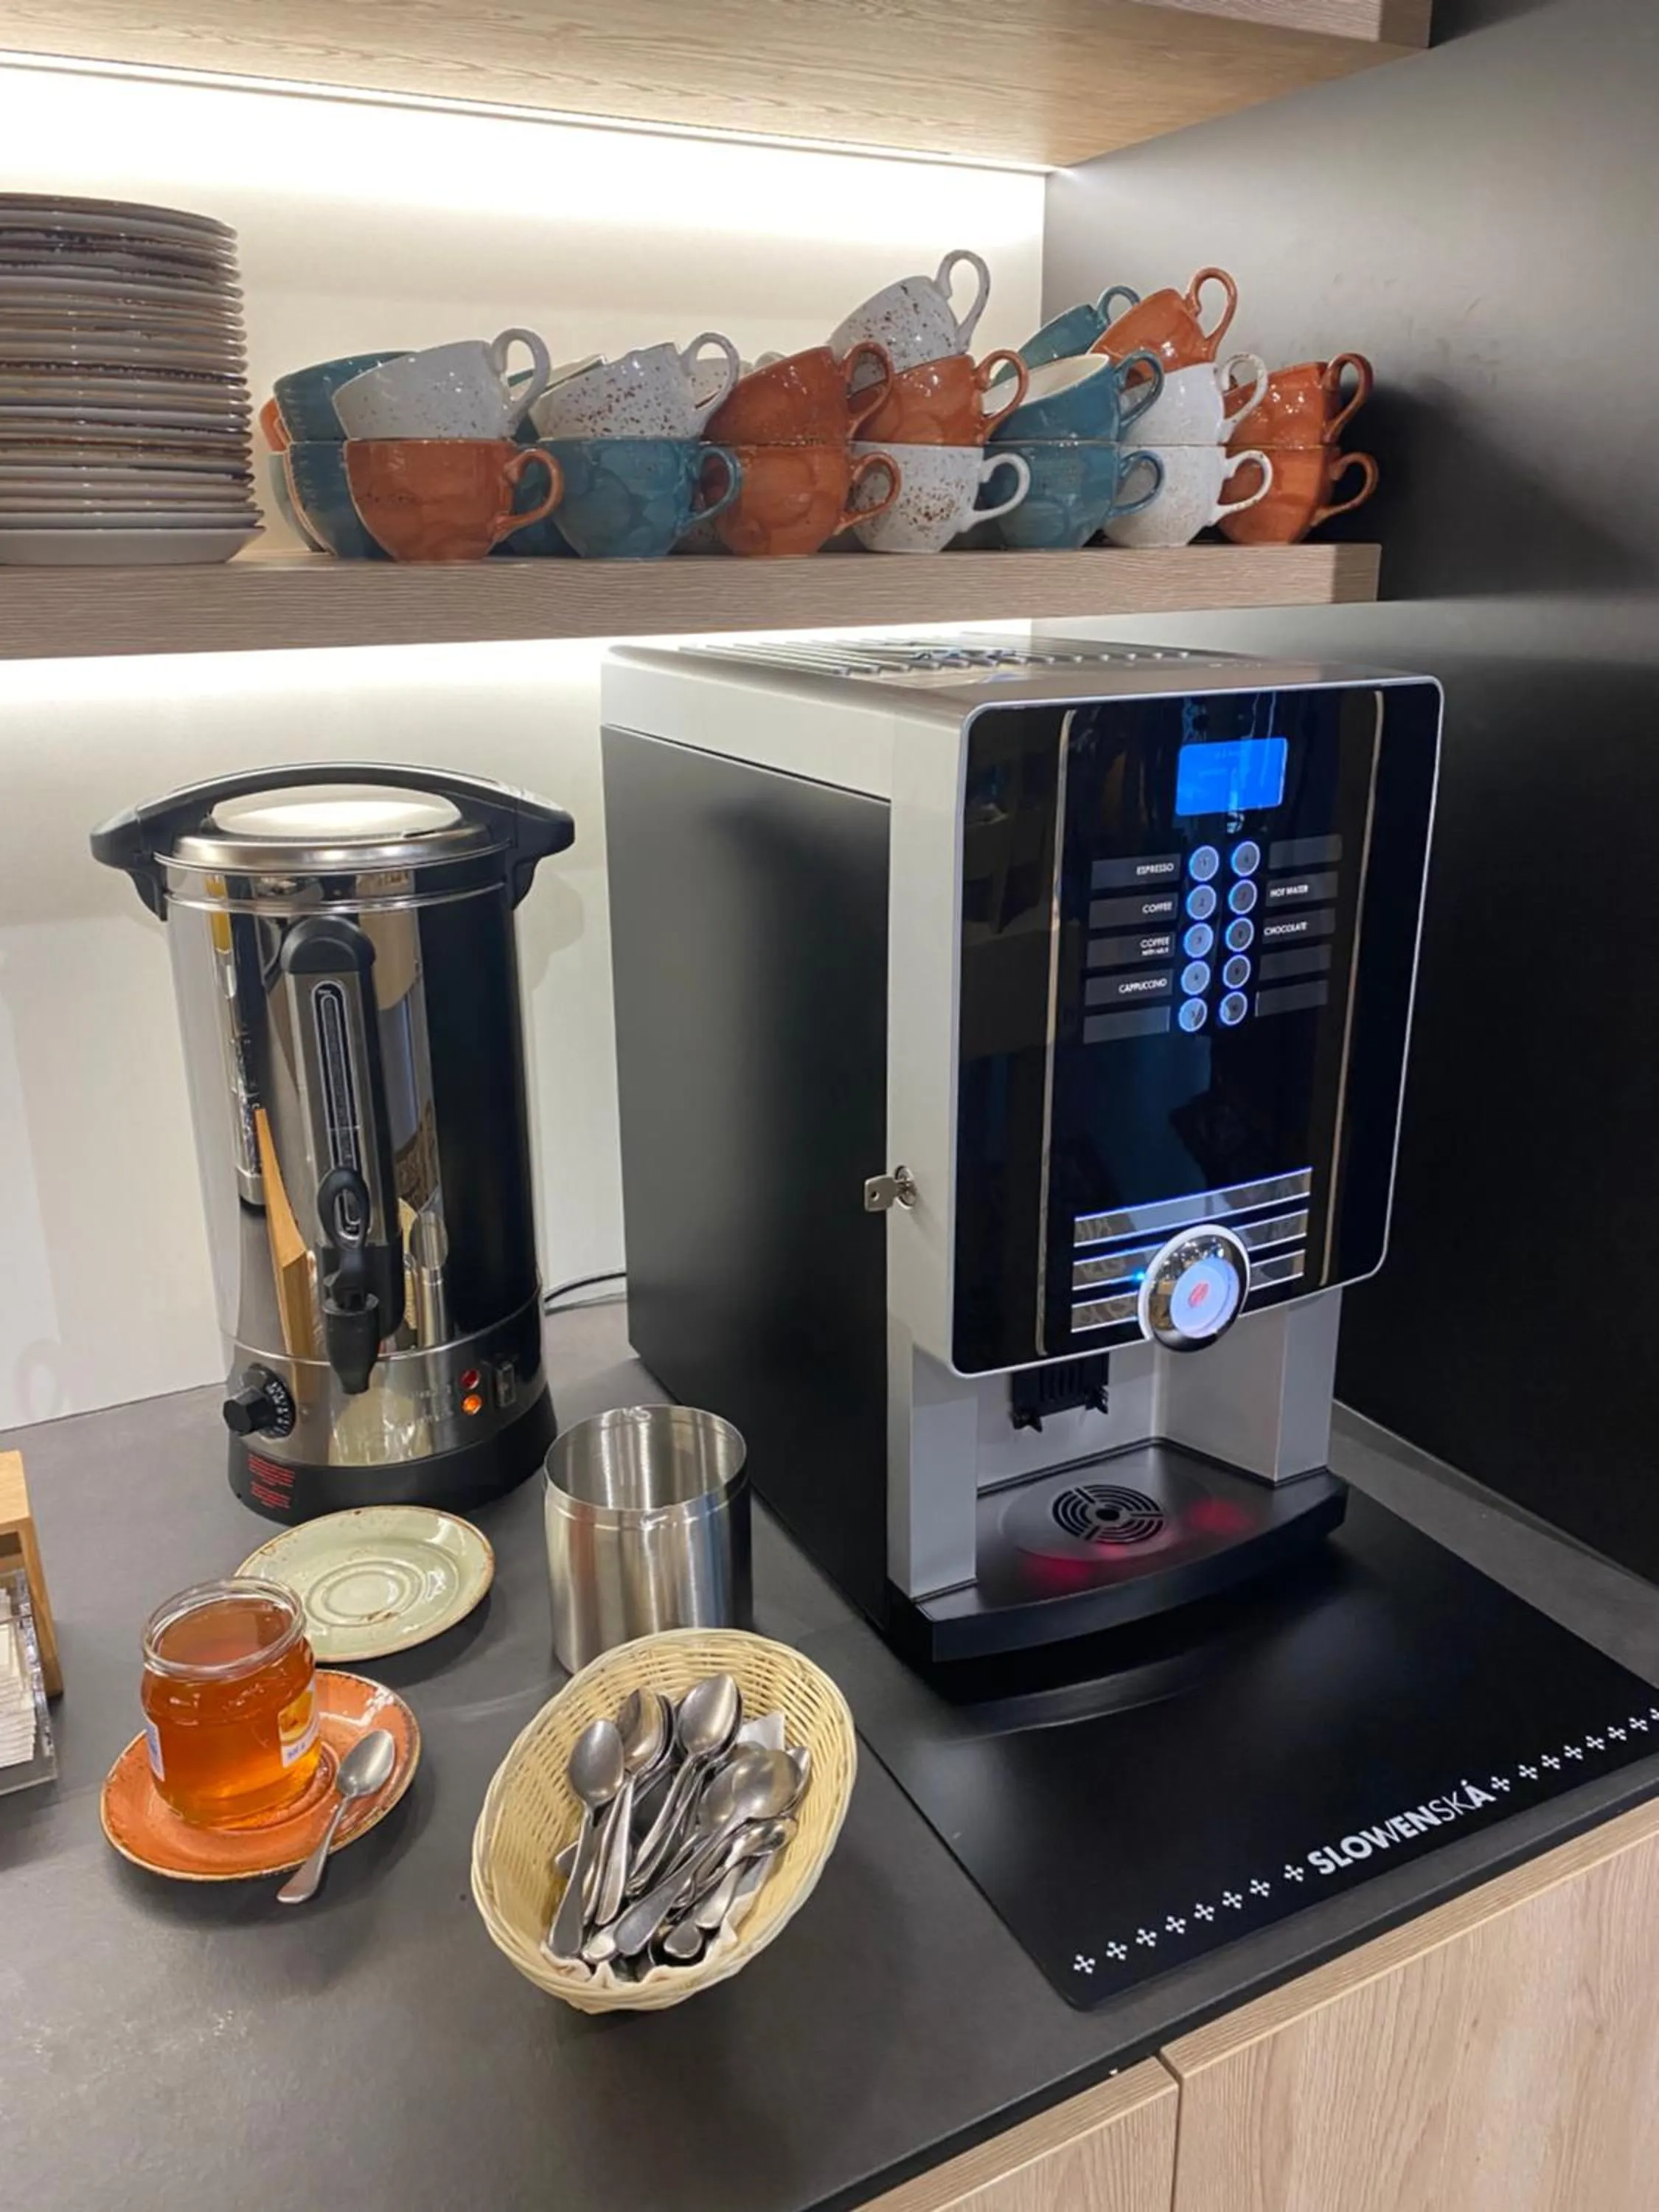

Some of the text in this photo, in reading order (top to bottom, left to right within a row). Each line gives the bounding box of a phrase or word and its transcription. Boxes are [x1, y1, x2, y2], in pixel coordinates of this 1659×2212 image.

[1136, 863, 1174, 876] ESPRESSO
[1270, 887, 1285, 897] HOT
[1142, 901, 1172, 914] COFFEE
[1264, 921, 1307, 936] CHOCOLATE
[1140, 936, 1169, 948] COFFEE
[1119, 978, 1167, 993] CAPPUCCINO
